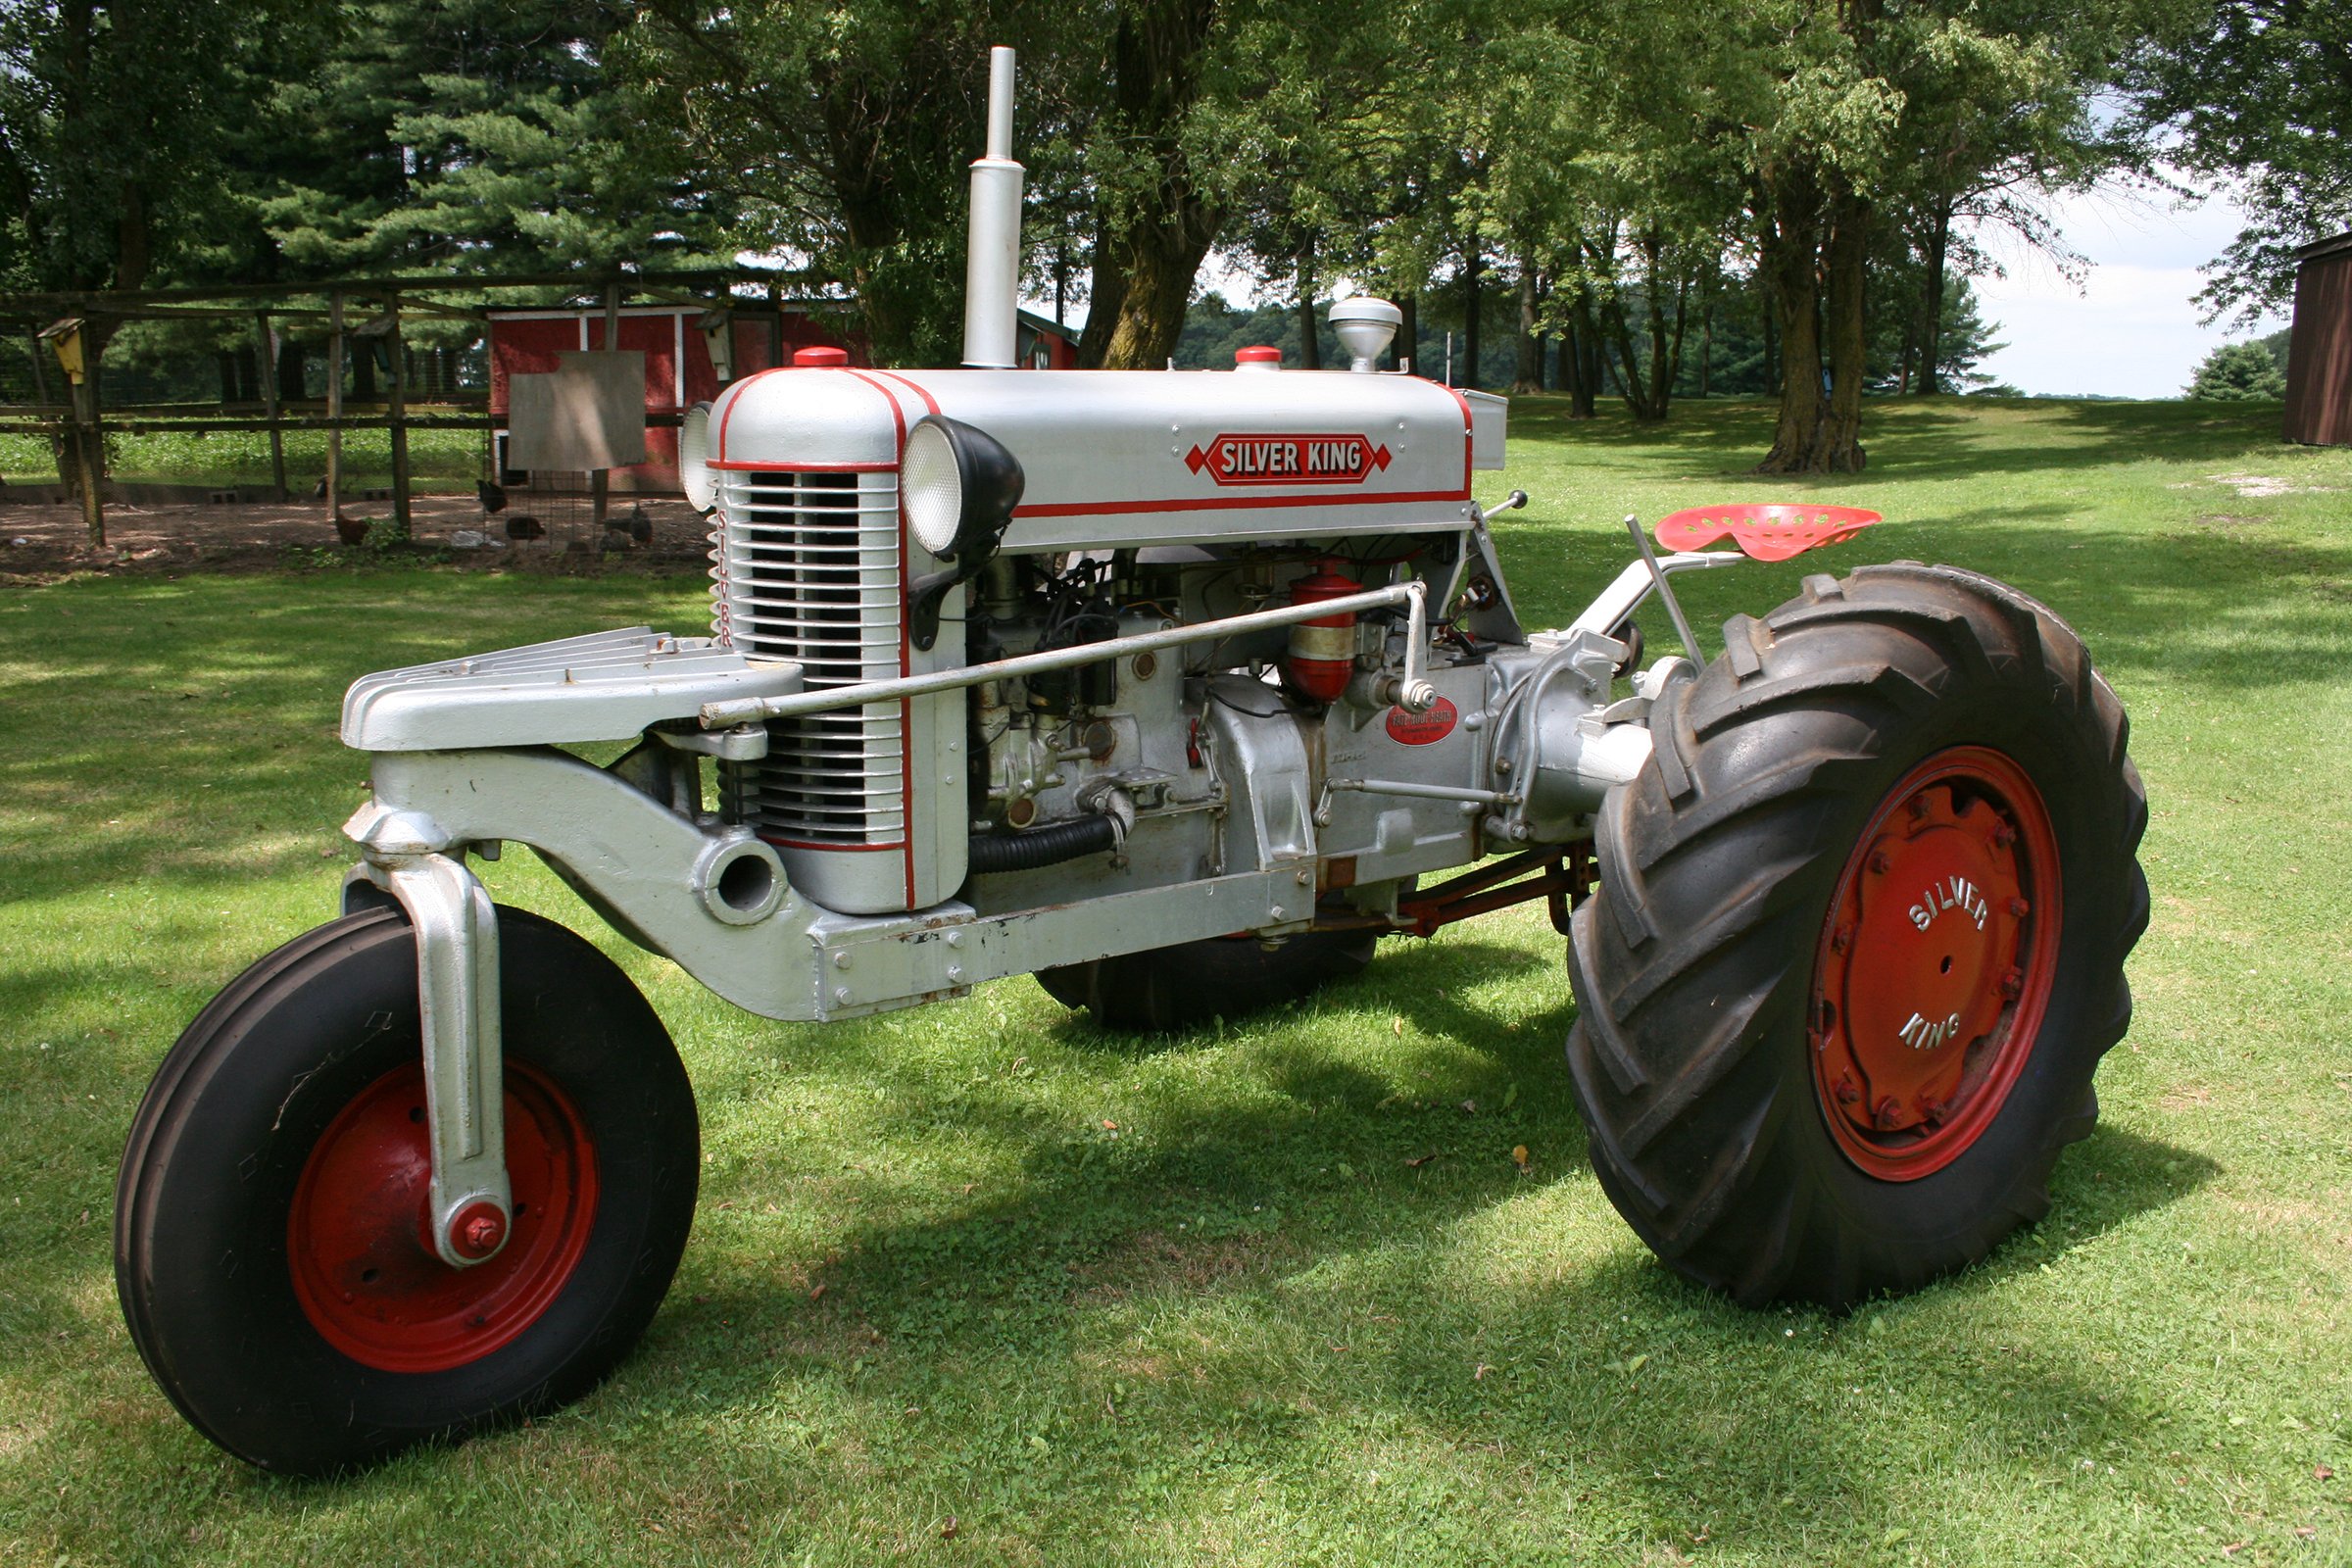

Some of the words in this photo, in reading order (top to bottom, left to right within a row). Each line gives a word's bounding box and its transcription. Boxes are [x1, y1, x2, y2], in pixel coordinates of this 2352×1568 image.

[1220, 442, 1299, 474] SILVER
[1307, 441, 1362, 472] KING
[717, 509, 733, 648] SILVER
[1909, 875, 1987, 932] SILVER
[1898, 1012, 1960, 1050] KING
